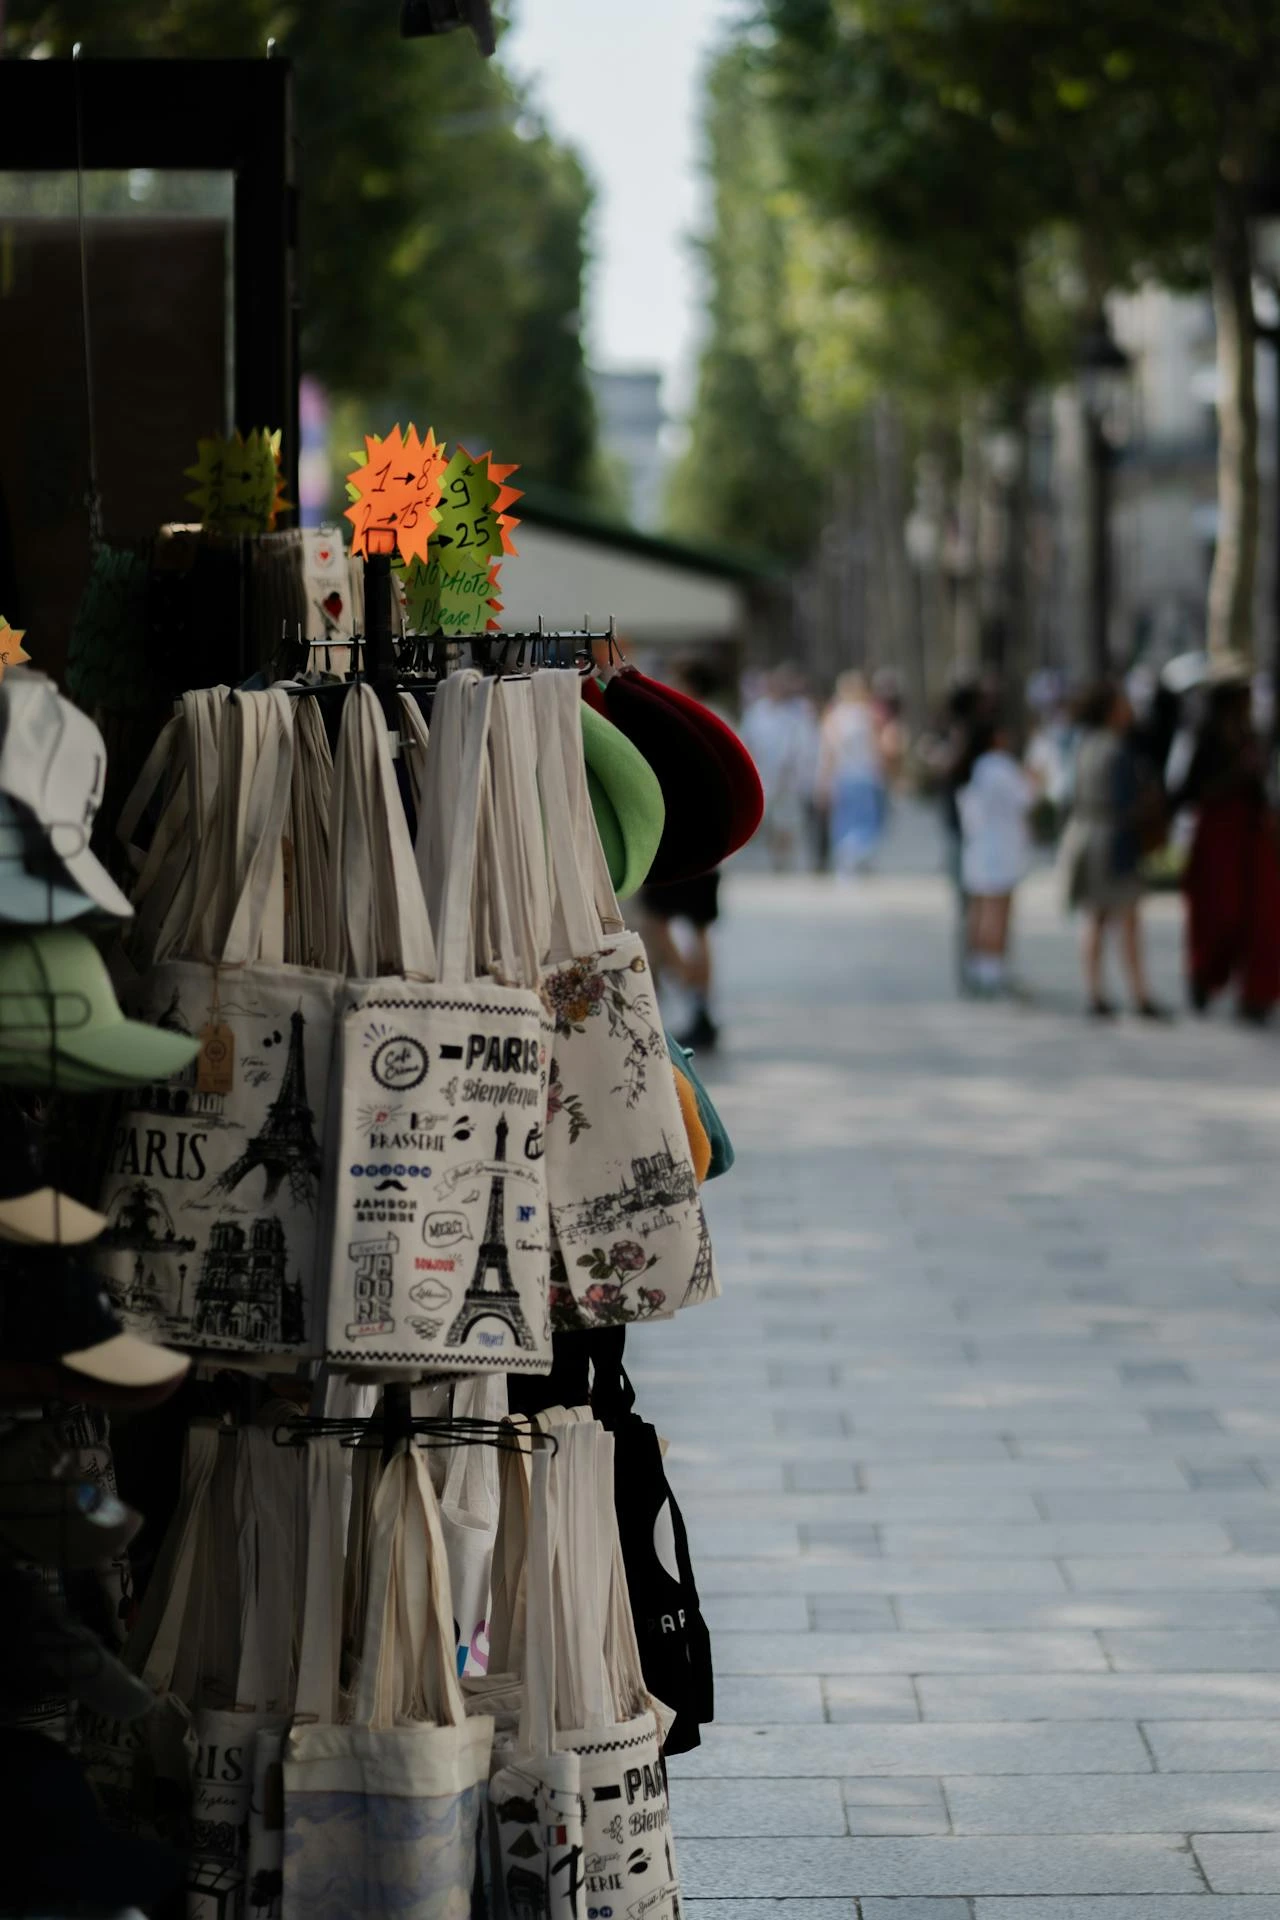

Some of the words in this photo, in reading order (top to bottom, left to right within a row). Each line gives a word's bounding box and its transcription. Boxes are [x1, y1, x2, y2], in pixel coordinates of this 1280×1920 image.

[372, 459, 392, 492] 1
[464, 1034, 539, 1075] PARIS
[370, 1132, 447, 1152] BRASSERIE
[353, 1199, 418, 1210] JAMBON
[357, 1212, 414, 1223] BEURRE
